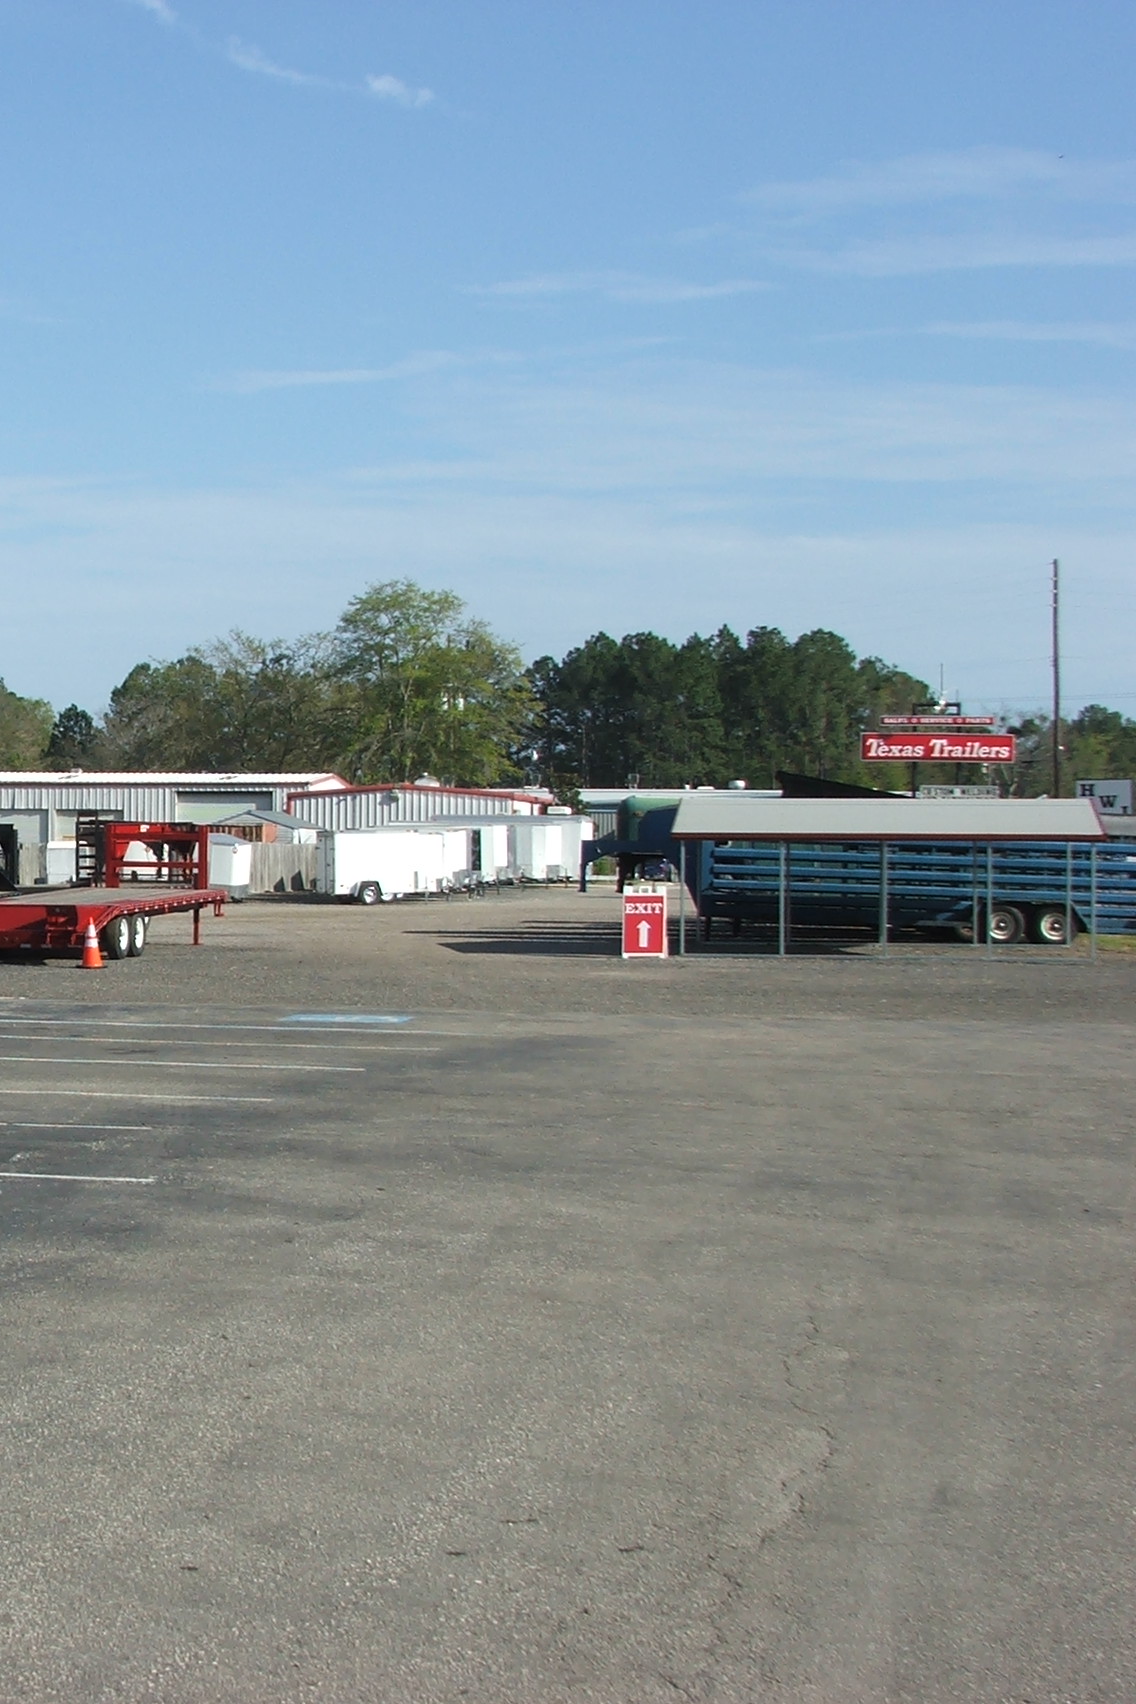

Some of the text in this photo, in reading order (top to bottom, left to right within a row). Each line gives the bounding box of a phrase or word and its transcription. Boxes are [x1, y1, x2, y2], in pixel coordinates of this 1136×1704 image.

[866, 739, 1010, 758] Texas Trailers
[625, 903, 663, 914] EXIT
